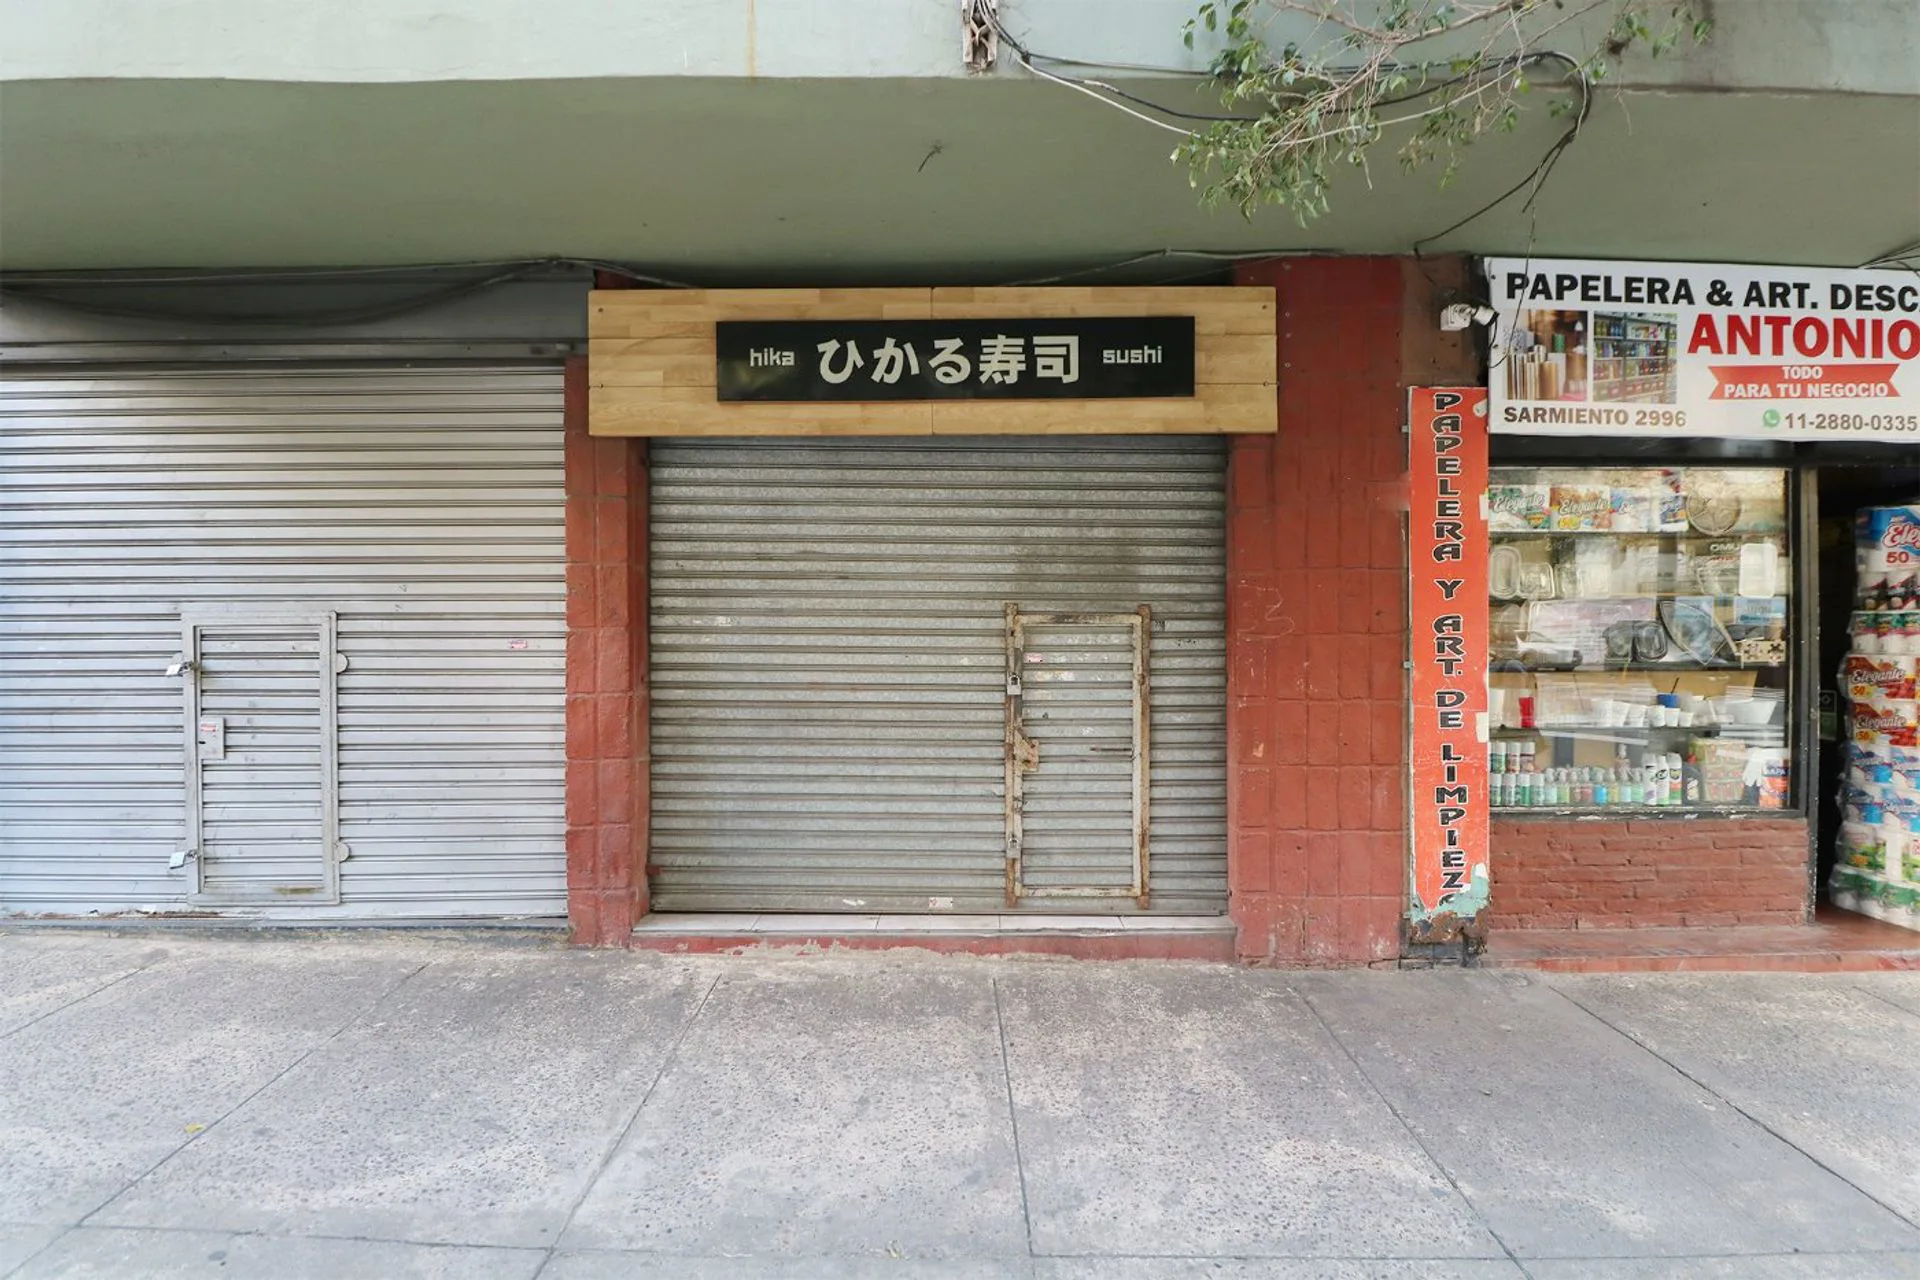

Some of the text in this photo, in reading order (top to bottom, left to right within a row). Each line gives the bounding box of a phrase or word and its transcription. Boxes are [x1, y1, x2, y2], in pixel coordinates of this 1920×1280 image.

[1506, 272, 1920, 313] PAPELERA & ART. DESC
[1687, 313, 1920, 360] ANTONIO
[749, 347, 795, 367] hika
[816, 334, 1080, 385] ひかる寿司
[1102, 345, 1163, 364] sushi
[1782, 366, 1823, 380] TODO
[1724, 382, 1889, 398] PARA TU NEGOCIO
[1504, 406, 1687, 428] SARMIENTO 2996
[1784, 412, 1918, 432] 11-2880-0335
[1431, 392, 1466, 562] PAPELERA
[1887, 551, 1909, 563] 50
[1434, 579, 1465, 601] Y
[1432, 614, 1465, 675] ART.
[1435, 690, 1466, 728] DE
